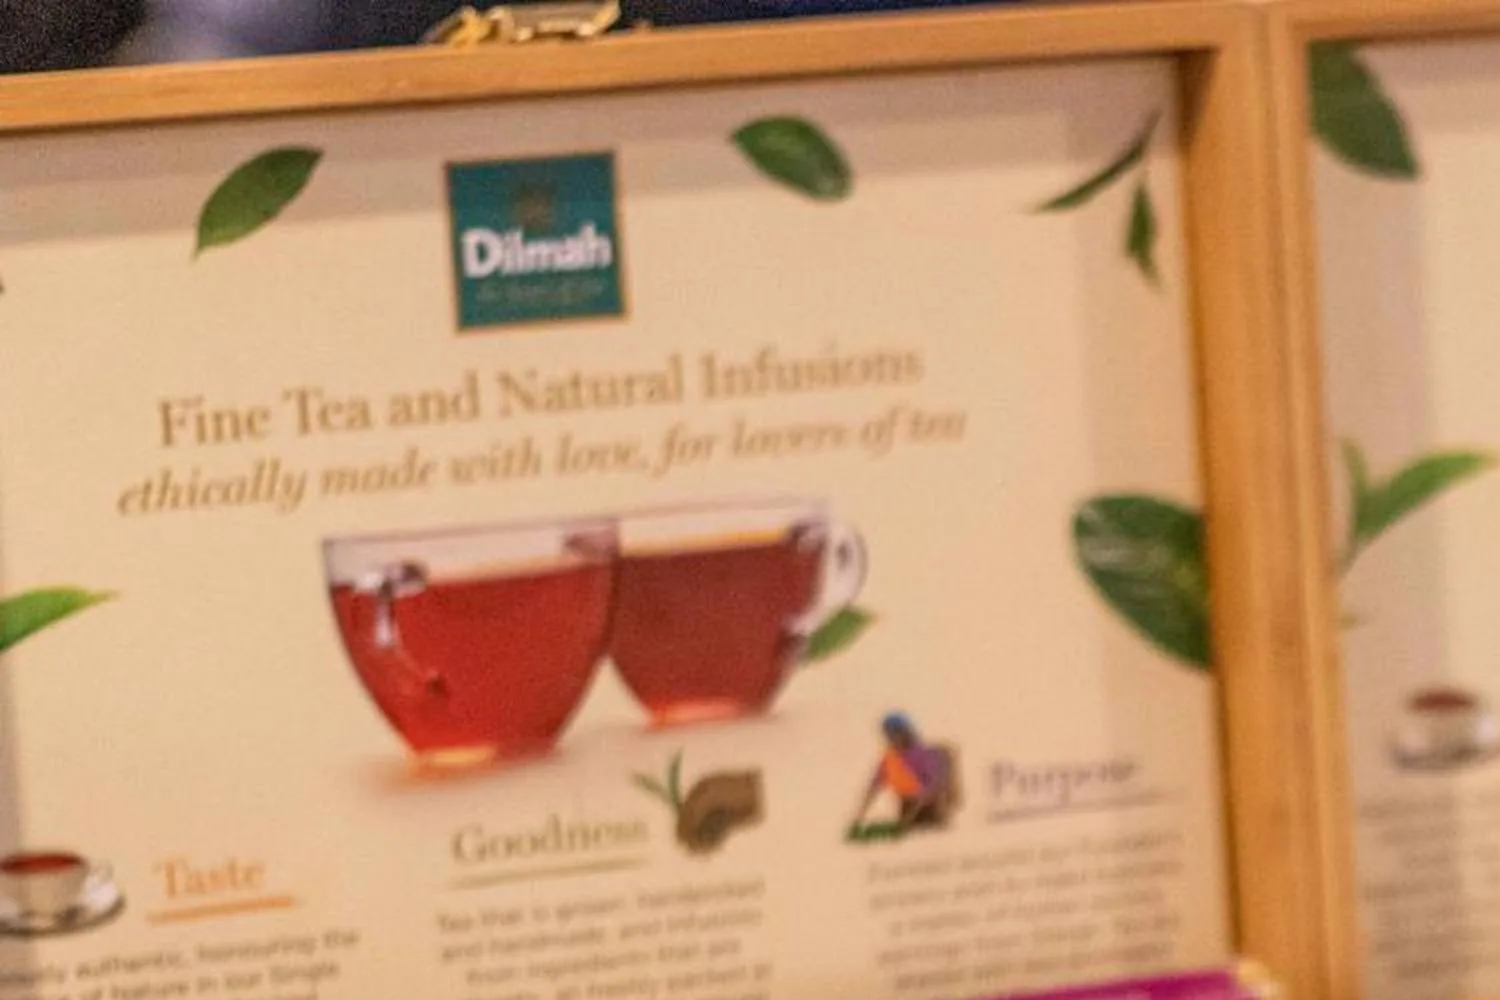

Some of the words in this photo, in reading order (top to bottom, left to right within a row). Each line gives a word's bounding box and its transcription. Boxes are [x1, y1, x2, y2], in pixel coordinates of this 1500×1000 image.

[462, 221, 613, 279] Dilmah
[157, 394, 272, 448] Fine
[282, 384, 372, 436] Tea
[388, 367, 480, 427] and
[495, 352, 684, 418] Natural
[700, 340, 926, 399] Infusions
[117, 456, 308, 517] ethically
[320, 446, 438, 496] made
[449, 436, 542, 485] with
[452, 811, 649, 865] Goodness
[154, 856, 267, 899] Taste
